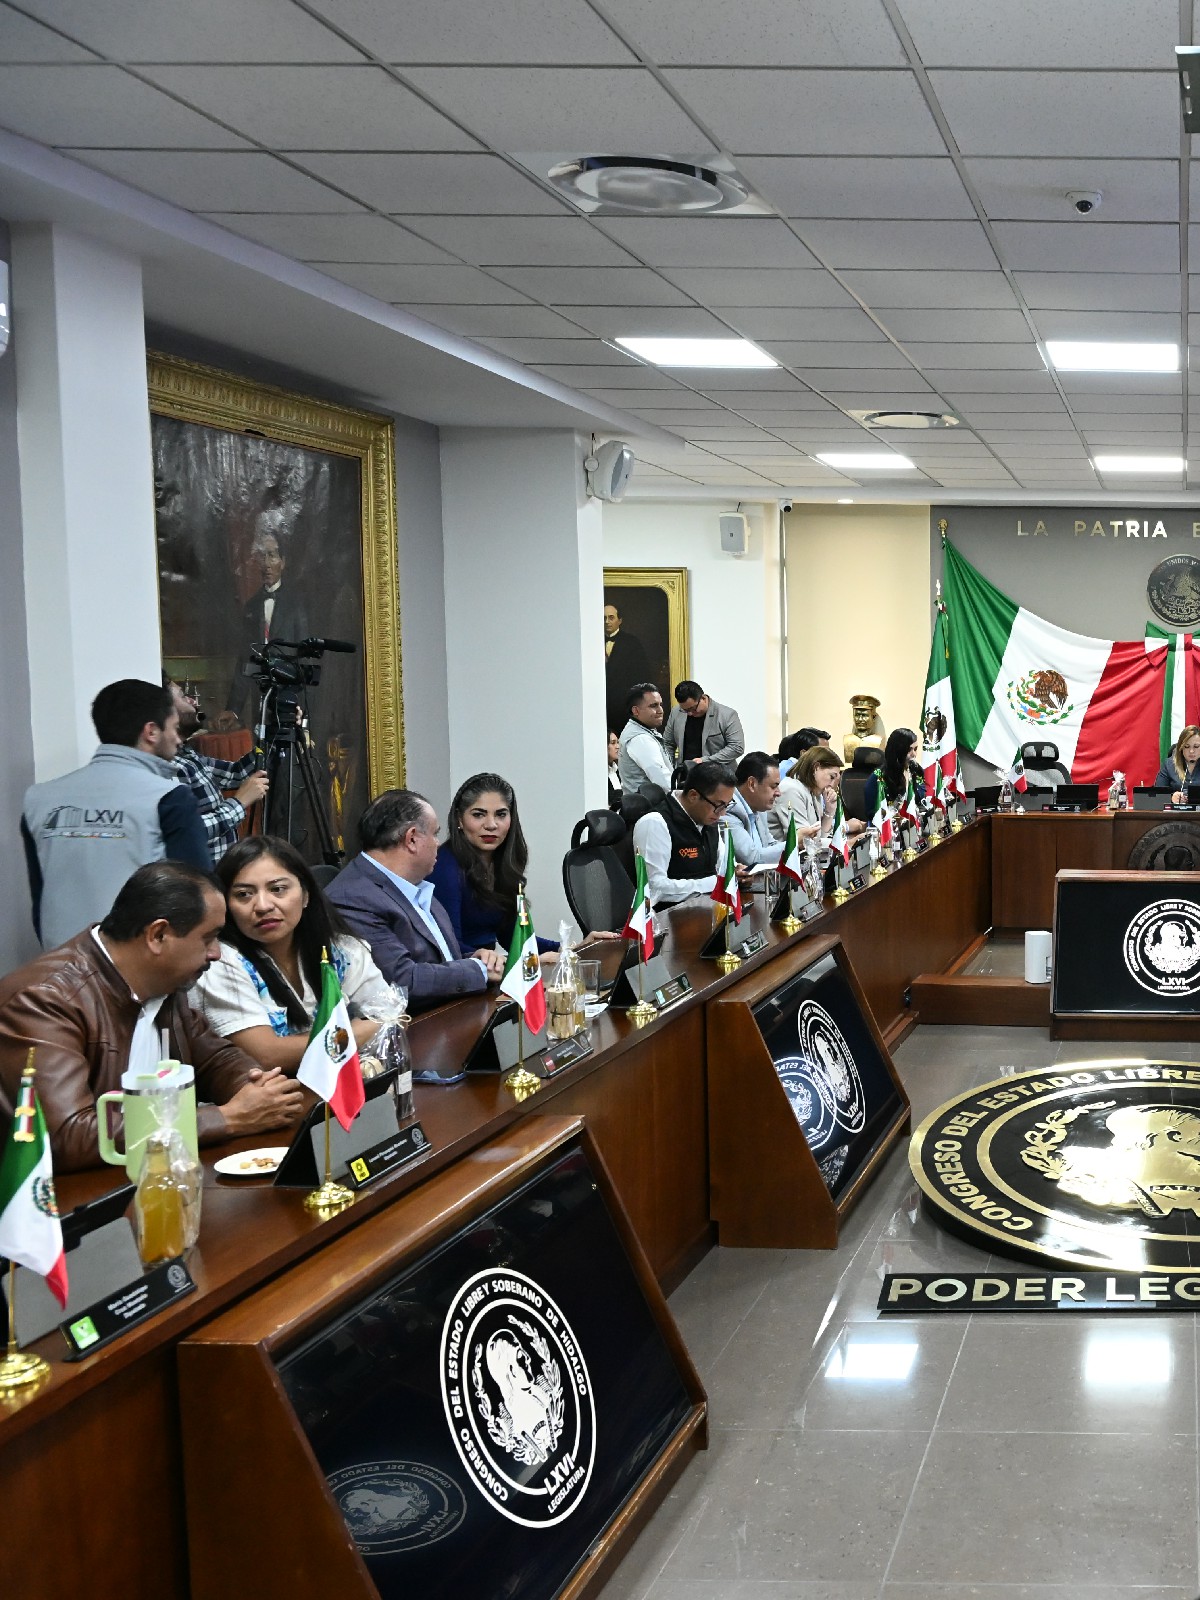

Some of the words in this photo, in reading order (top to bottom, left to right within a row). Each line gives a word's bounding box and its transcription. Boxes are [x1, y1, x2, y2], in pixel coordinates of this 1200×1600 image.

[1018, 520, 1048, 536] LA
[1074, 520, 1167, 538] PATRIA
[84, 810, 124, 824] LXVI
[1162, 977, 1186, 986] LXVI
[985, 1071, 1095, 1115] ESTADO
[955, 1105, 986, 1139] DEL
[934, 1133, 1033, 1232] CONGRESO
[461, 1286, 485, 1317] LIBRE
[482, 1282, 490, 1296] Y
[492, 1280, 542, 1308] SOBERANO
[888, 1278, 1084, 1302] PODER
[546, 1308, 559, 1328] DE
[448, 1319, 464, 1380] ESTADO
[560, 1330, 587, 1396] HIDALGO
[450, 1386, 464, 1418] DEL
[460, 1428, 508, 1501] CONGRESO
[544, 1452, 575, 1496] LXVI
[547, 1466, 586, 1514] LEGISLATURA
